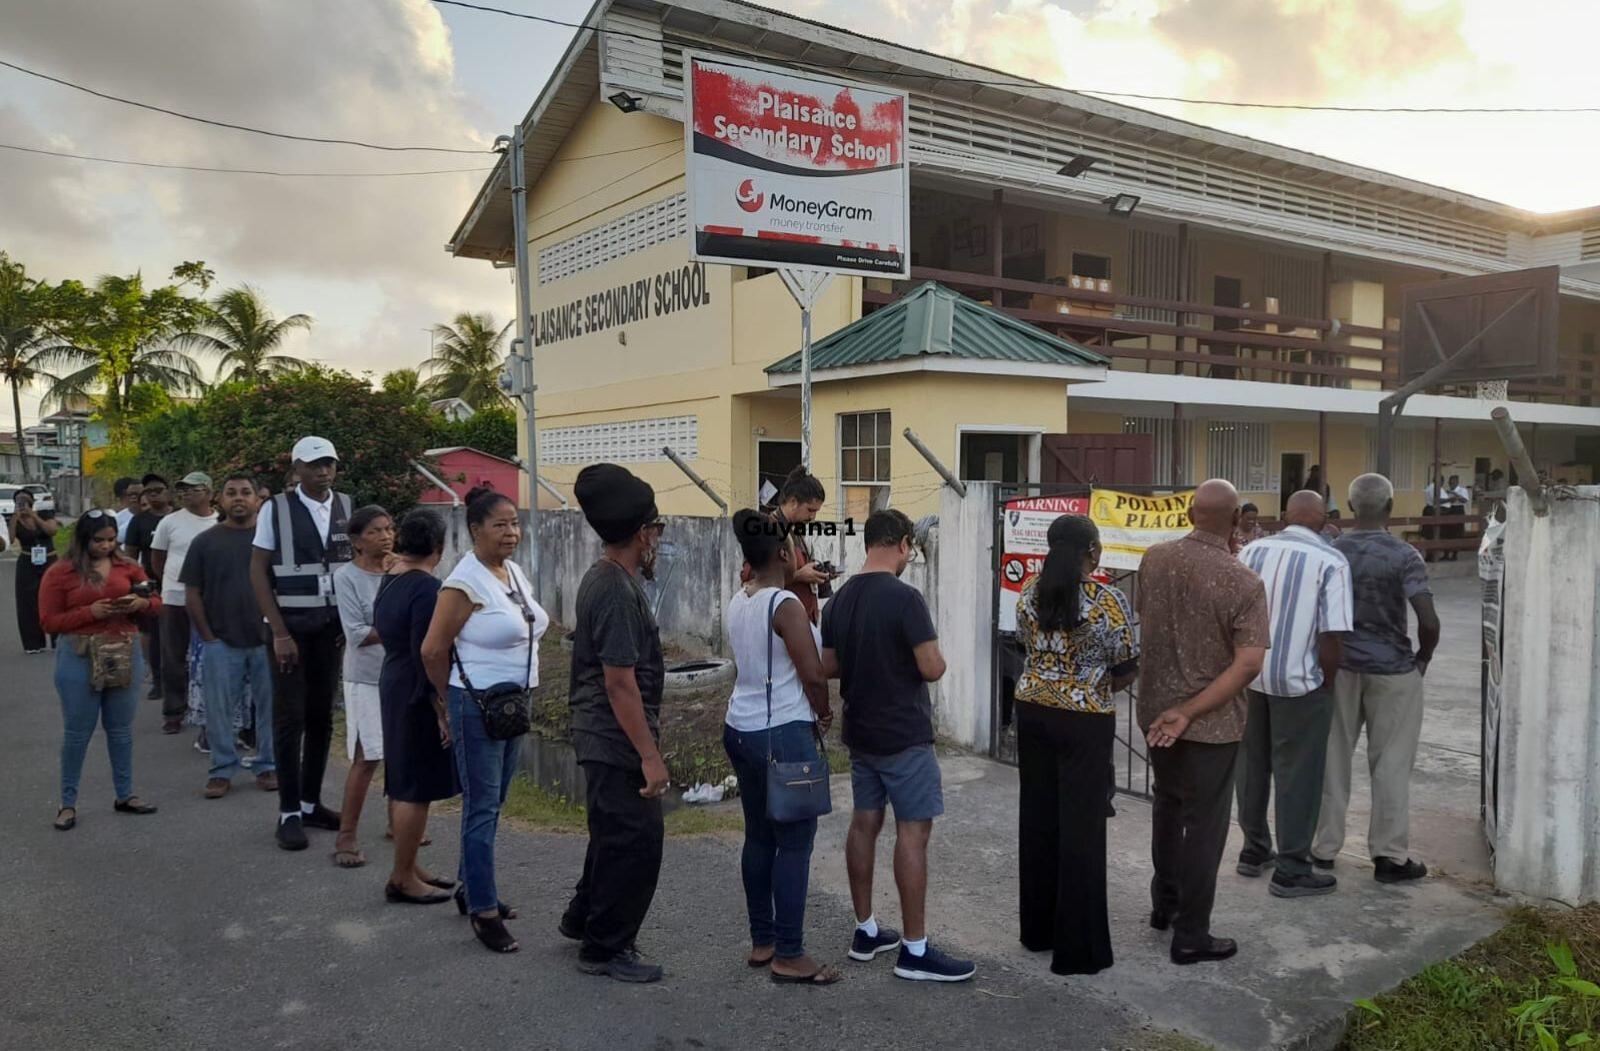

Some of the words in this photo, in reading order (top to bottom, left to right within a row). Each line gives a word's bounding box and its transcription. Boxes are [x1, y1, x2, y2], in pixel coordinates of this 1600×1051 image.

[757, 91, 857, 130] Plaisance
[713, 114, 822, 160] Secondary
[830, 133, 892, 165] School
[769, 193, 873, 222] MoneyGram
[769, 216, 804, 232] money
[805, 220, 845, 234] transfer
[836, 255, 857, 263] Please
[858, 257, 873, 265] Drive
[874, 259, 900, 268] Carefully
[585, 277, 652, 334] SECONDARY
[654, 261, 710, 317] SCHOOL
[1016, 498, 1080, 513] WARNING
[1125, 512, 1189, 529] PLACE
